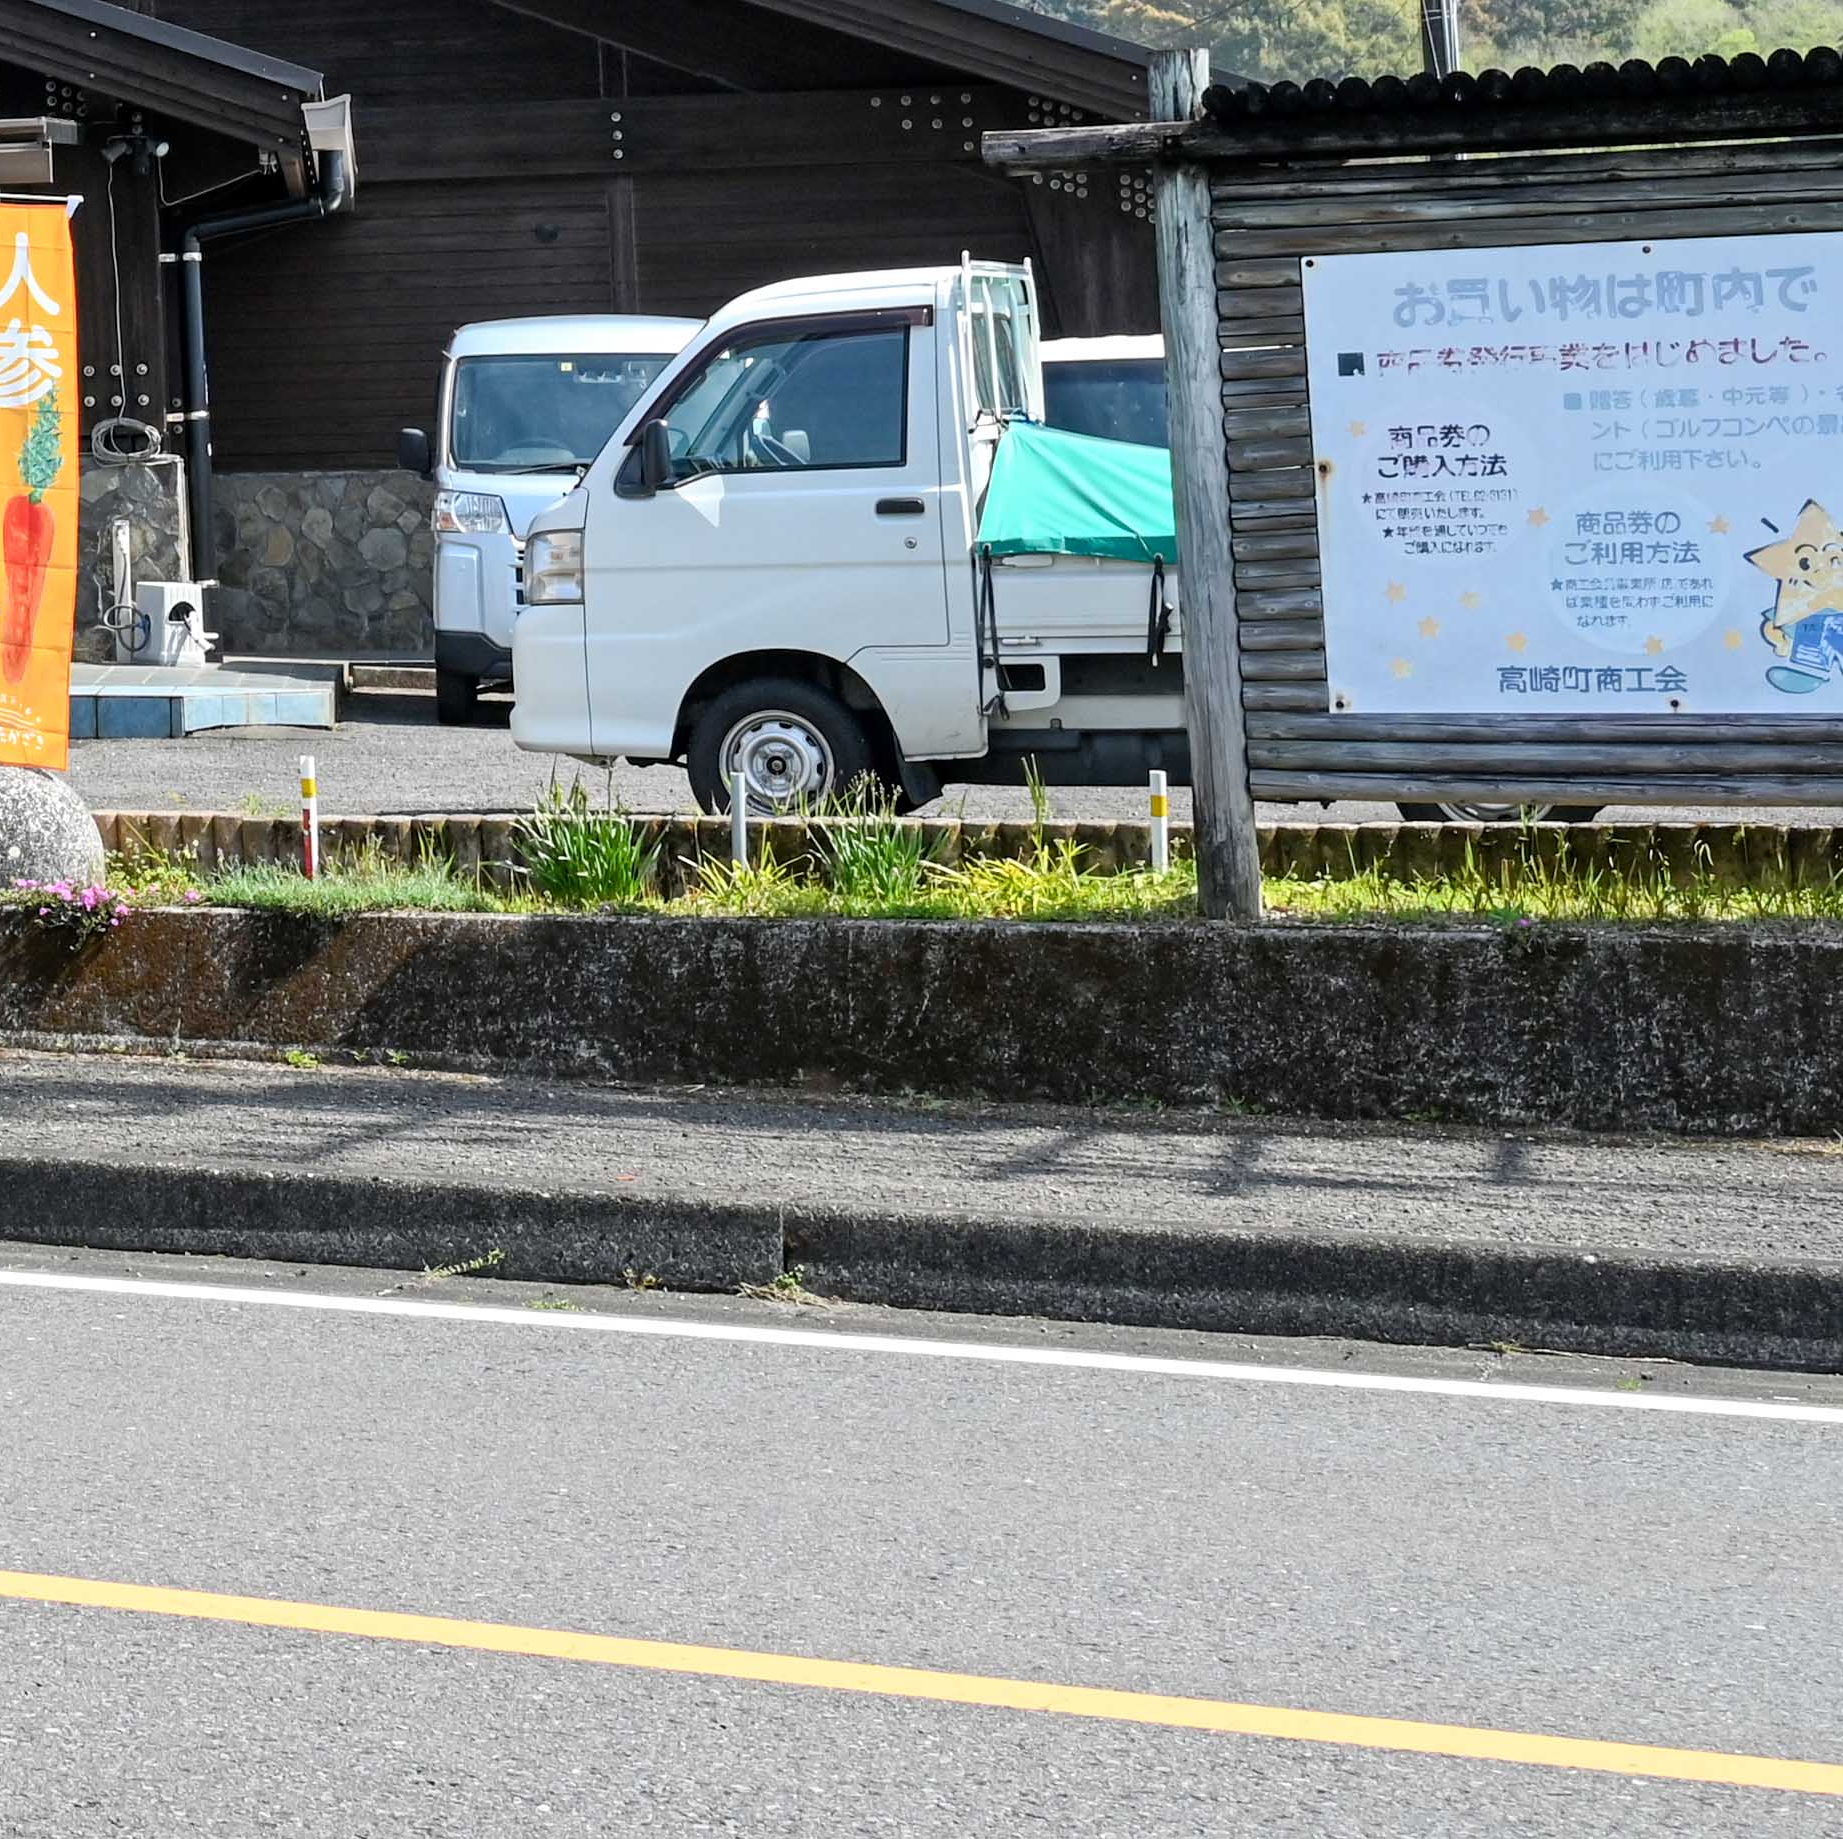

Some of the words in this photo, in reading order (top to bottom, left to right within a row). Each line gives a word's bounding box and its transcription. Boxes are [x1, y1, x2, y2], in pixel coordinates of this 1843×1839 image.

[1392, 264, 1818, 328] お買い物は町内で
[1377, 453, 1508, 479] ご購入方法
[1593, 448, 1763, 472] にご利用下さい。
[1575, 511, 1681, 537] 商品券の
[1564, 539, 1702, 566] ご利用方法
[1496, 665, 1689, 693] 高崎町商工会
